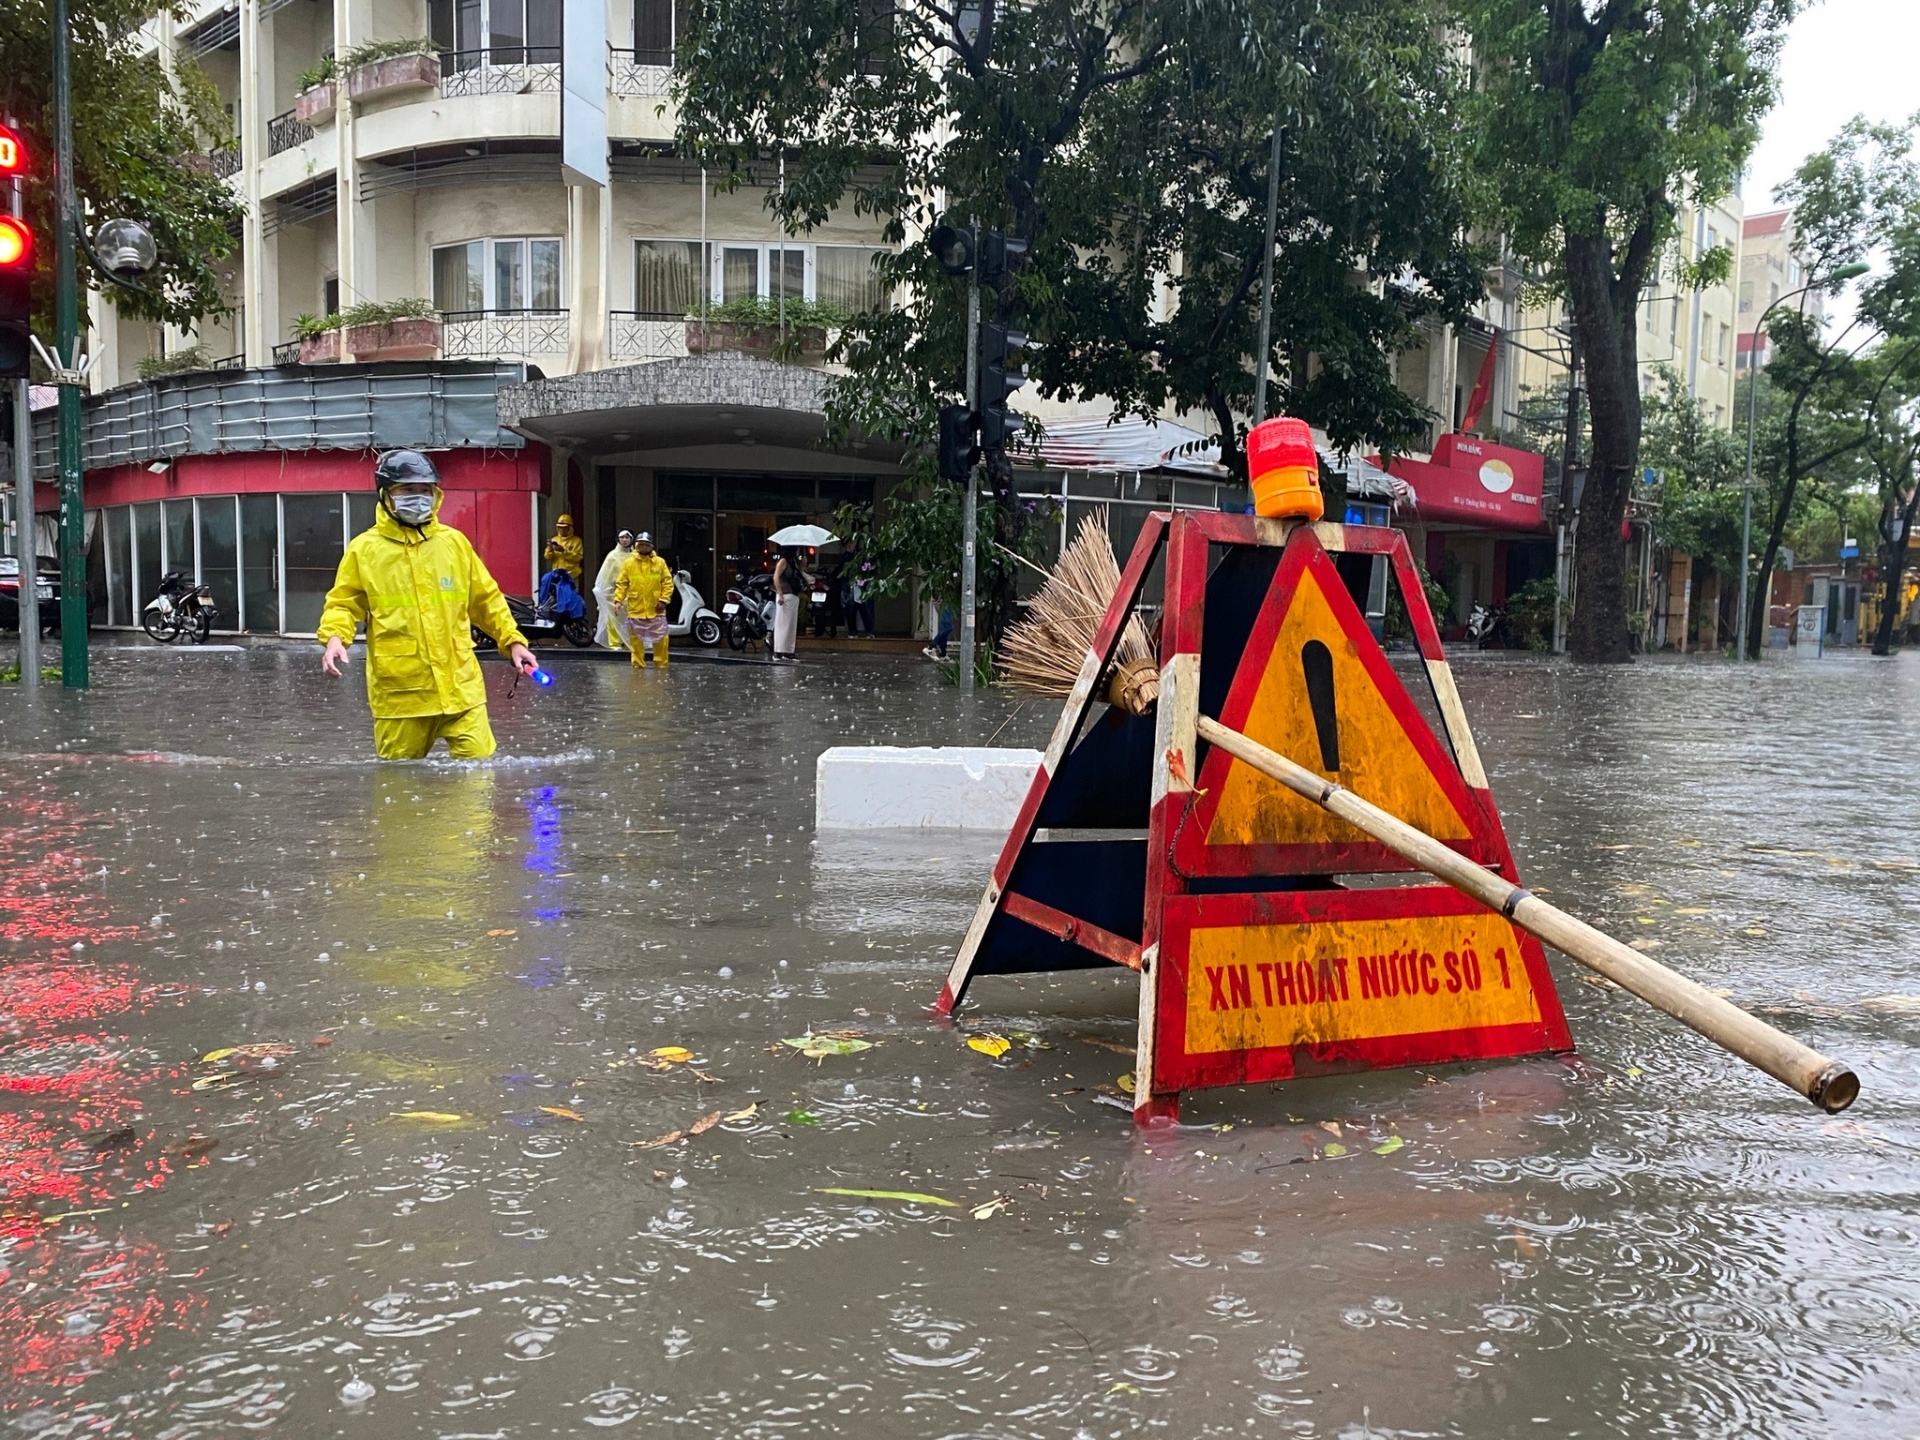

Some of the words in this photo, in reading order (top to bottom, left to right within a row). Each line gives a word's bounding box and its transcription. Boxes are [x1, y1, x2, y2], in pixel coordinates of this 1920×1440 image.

[1205, 964, 1252, 1011] XN
[1256, 946, 1349, 1007] THOÁT
[1357, 939, 1439, 1000] NƯỚC
[1443, 931, 1482, 994] SỐ
[1494, 948, 1511, 990] 1
